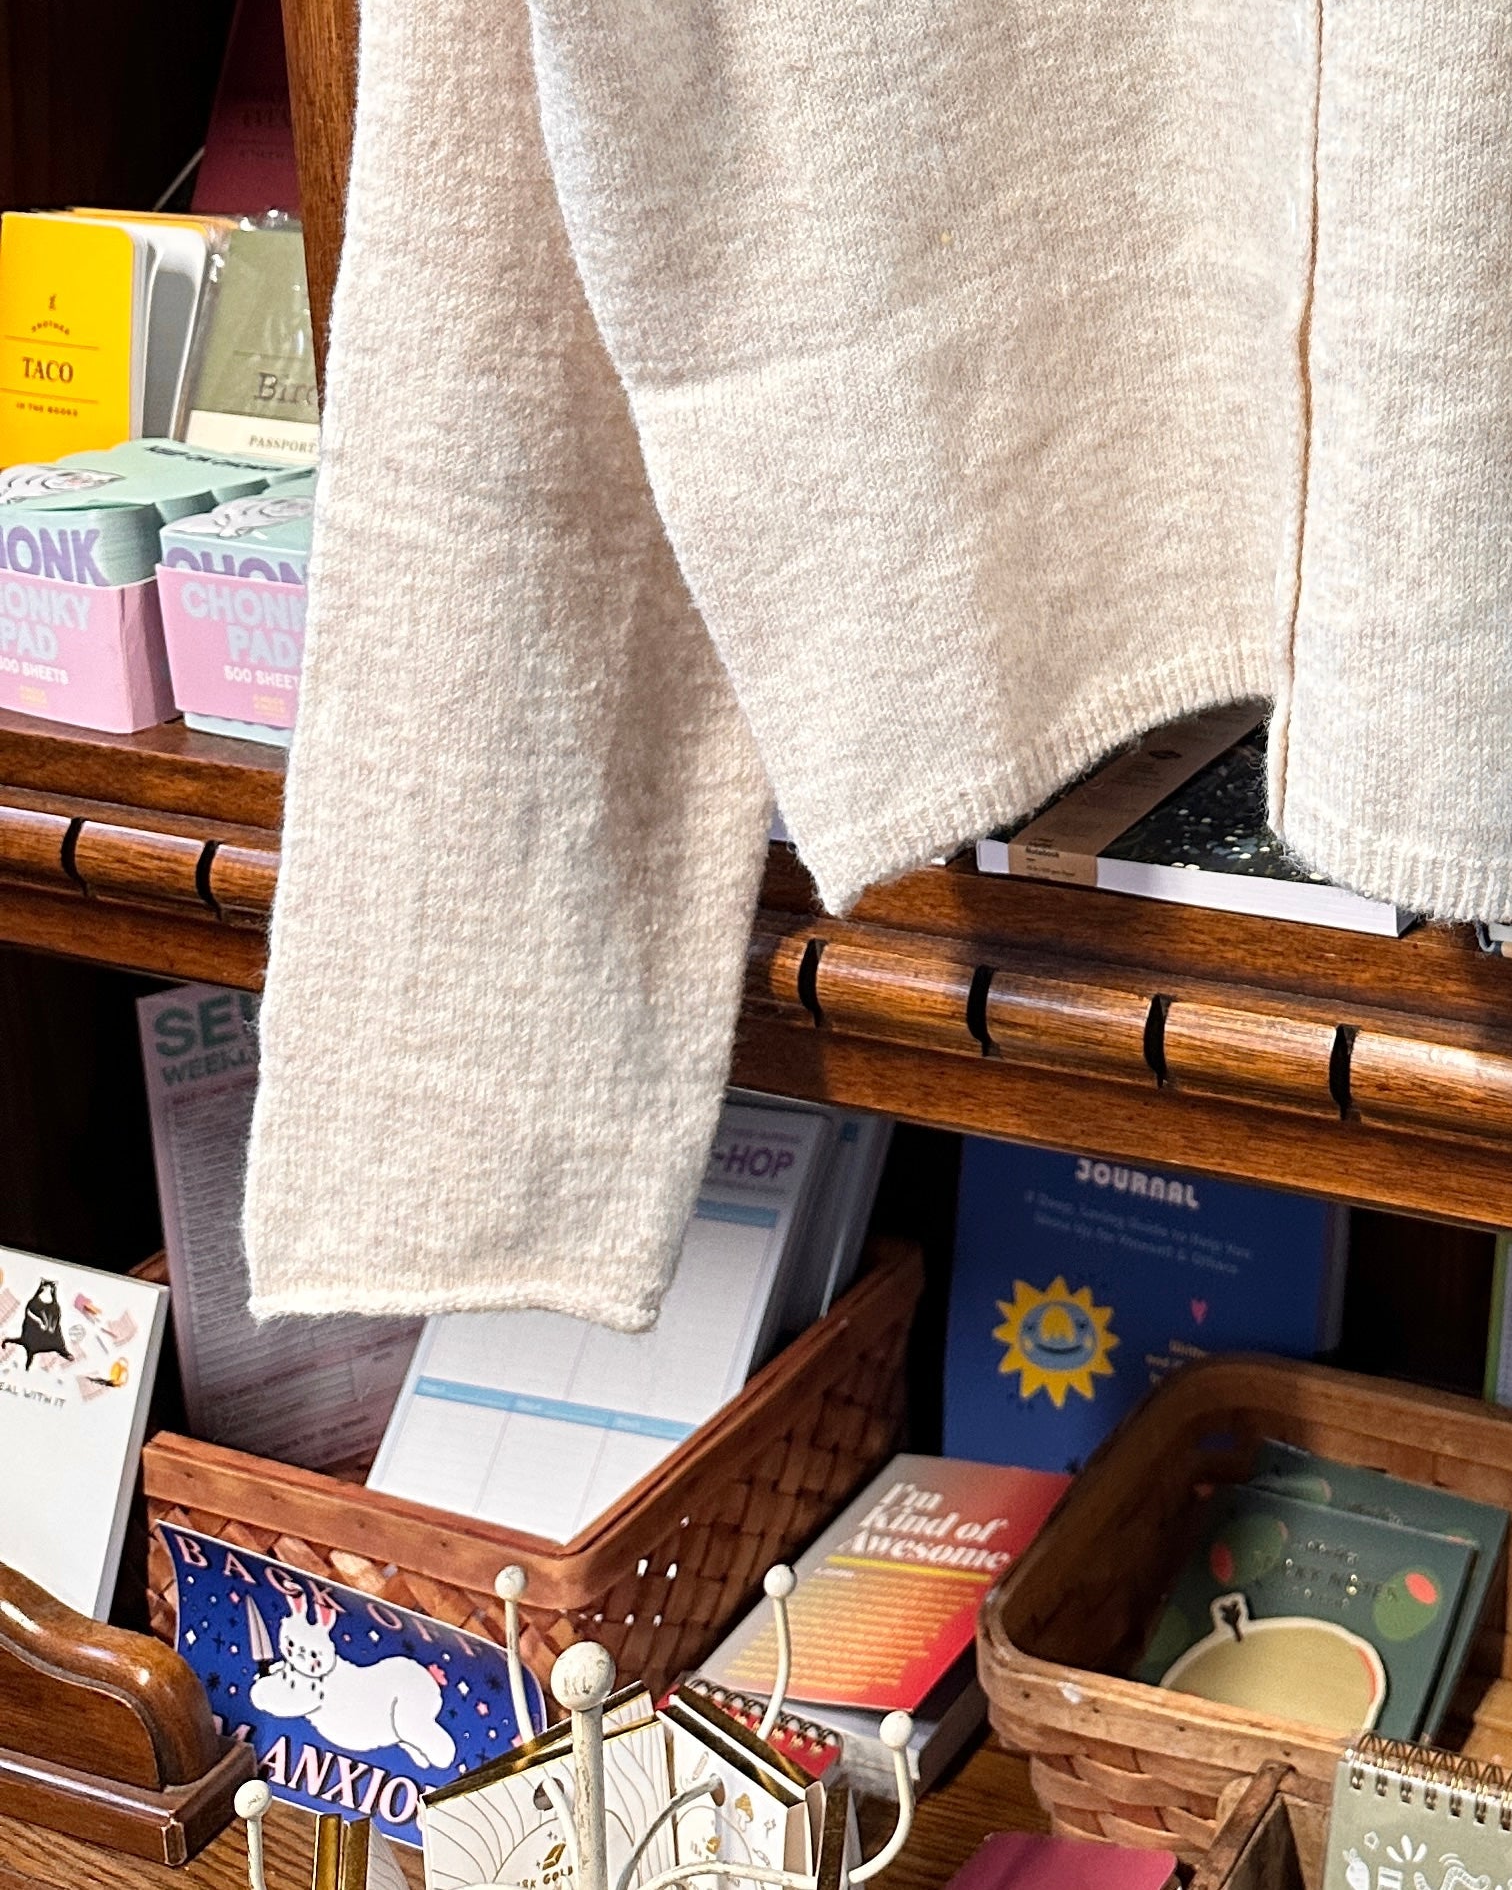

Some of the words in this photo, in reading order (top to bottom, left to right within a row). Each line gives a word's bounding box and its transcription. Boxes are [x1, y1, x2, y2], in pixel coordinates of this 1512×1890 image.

[22, 356, 74, 383] TACO
[249, 435, 317, 453] PASSPORT
[0, 580, 92, 632] ONKY
[227, 624, 300, 668] PAD
[22, 662, 69, 685] SHEETS
[223, 665, 251, 683] 500
[1074, 1159, 1199, 1210] JOURNAL
[878, 1482, 944, 1510] I'm
[858, 1503, 960, 1534] Kind
[955, 1517, 1009, 1545] of
[836, 1528, 1011, 1570] Awesome
[174, 1533, 346, 1614] BACK
[258, 1736, 437, 1824] ANXIO
[543, 1865, 573, 1885] GOLD
